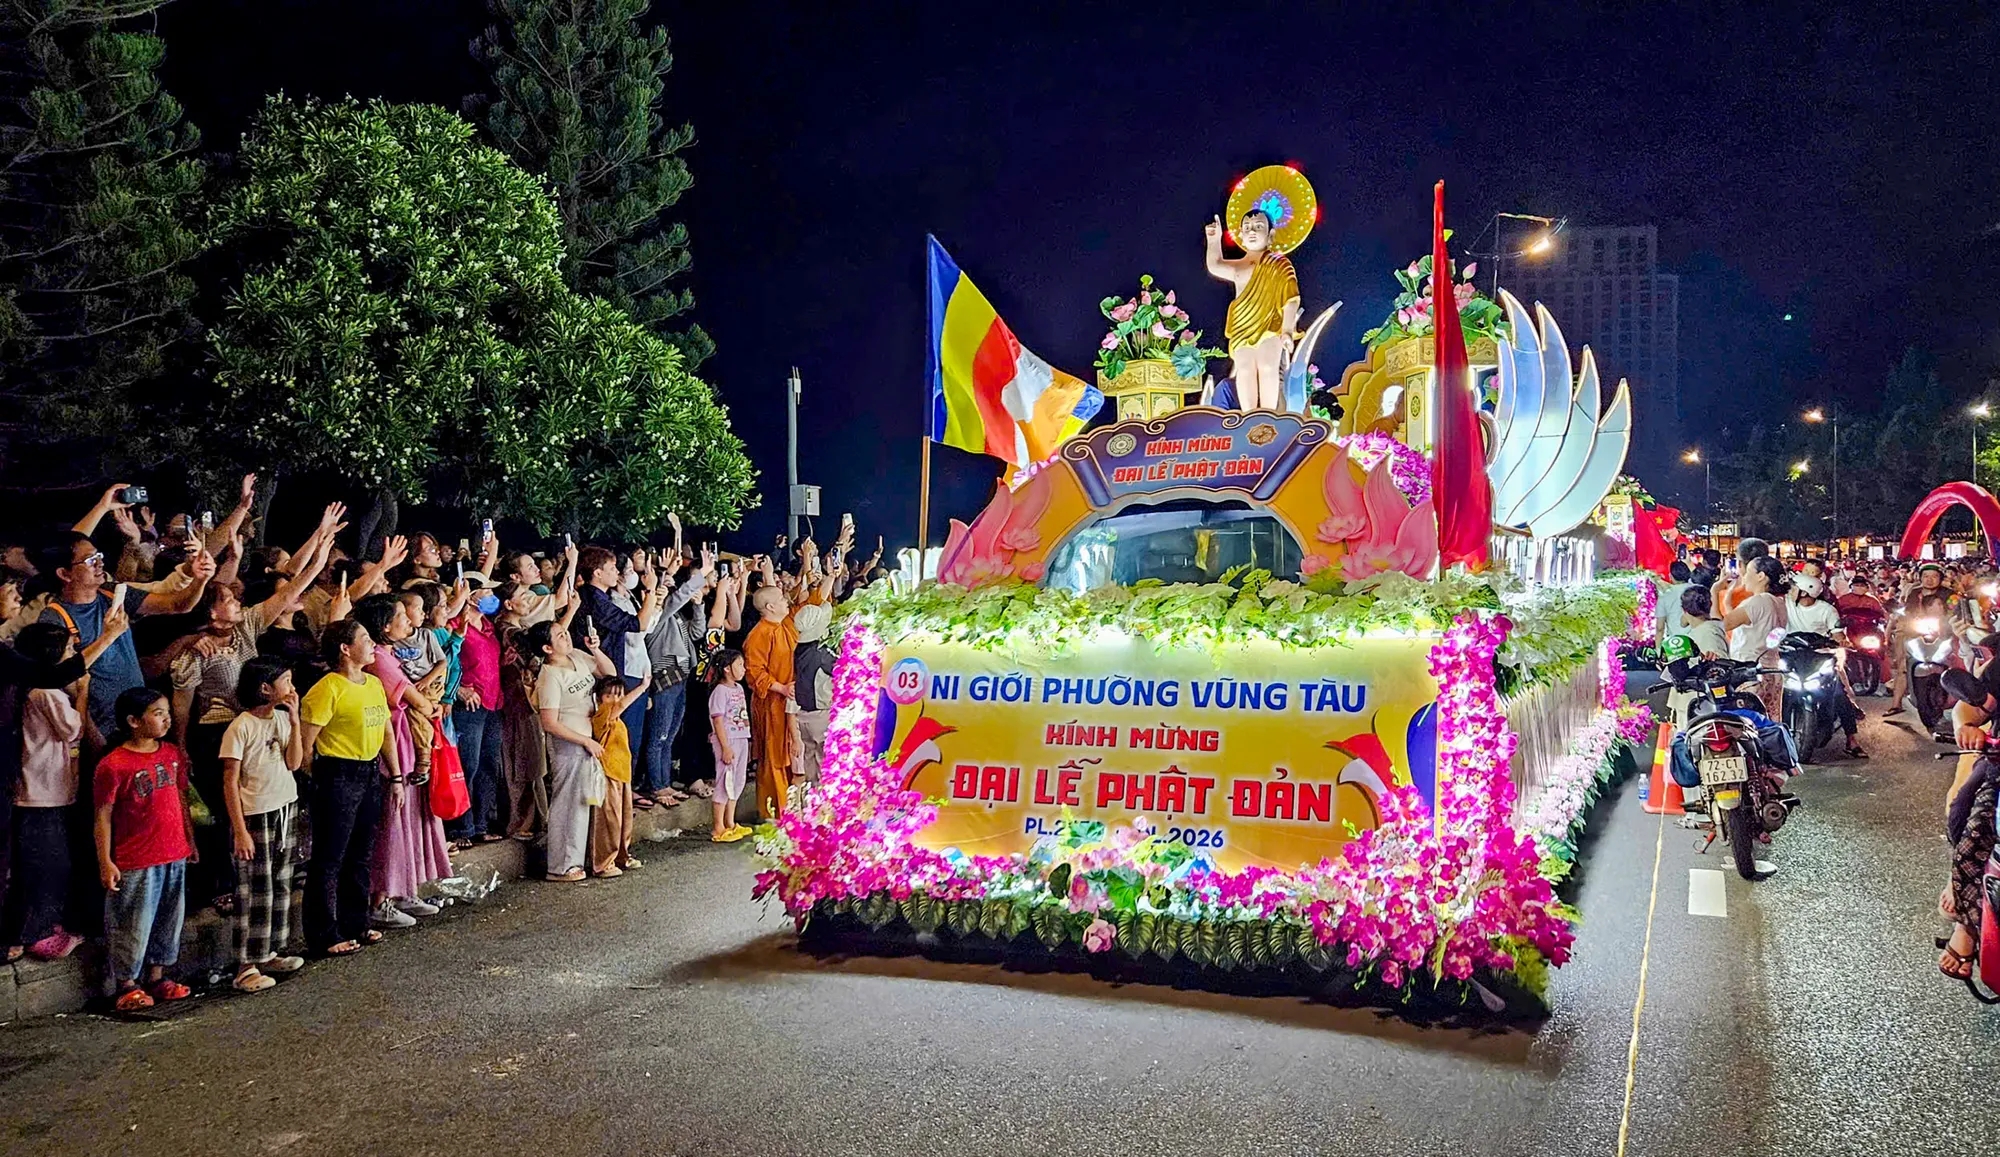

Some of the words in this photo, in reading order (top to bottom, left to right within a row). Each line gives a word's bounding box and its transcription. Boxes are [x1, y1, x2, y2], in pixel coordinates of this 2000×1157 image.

[1145, 437, 1183, 456] KÍNH
[1187, 434, 1232, 453] MỪNG
[1112, 467, 1144, 485] ĐẠI
[1147, 458, 1177, 481] LỄ
[1172, 457, 1220, 481] PHẬT
[1221, 454, 1263, 476] ĐẢN
[898, 671, 919, 689] 03
[931, 675, 960, 700] NI
[969, 671, 1032, 702] GIỚI
[1042, 674, 1179, 707] PHƯỜNG
[1191, 677, 1288, 710] VŨNG
[1300, 678, 1366, 713] TÀU
[1045, 719, 1118, 747] KÍNH
[1129, 722, 1219, 752] MỪNG
[1706, 769, 1744, 783] 162.32
[1707, 758, 1738, 771] 72-C1
[949, 764, 1021, 808] ĐẠI
[1034, 758, 1103, 806] LỄ
[1096, 765, 1215, 821] PHẬT
[1227, 767, 1332, 822] ĐẢN
[1130, 825, 1224, 848] L.2026
